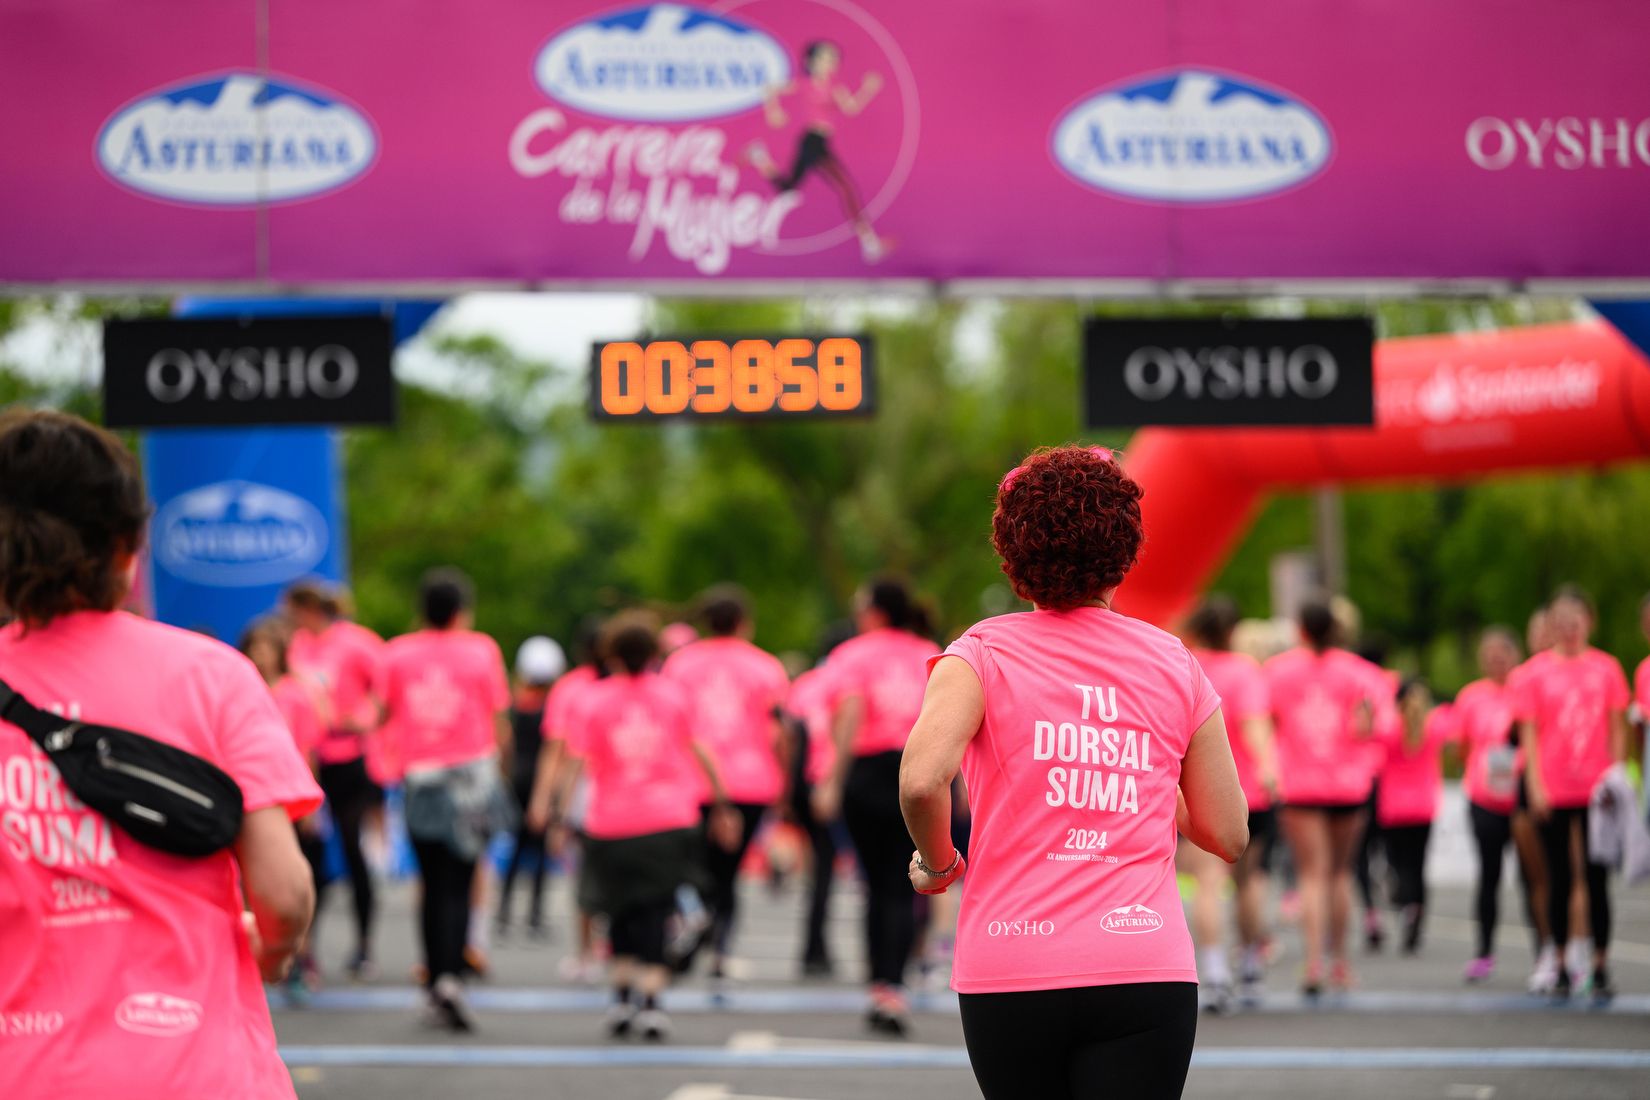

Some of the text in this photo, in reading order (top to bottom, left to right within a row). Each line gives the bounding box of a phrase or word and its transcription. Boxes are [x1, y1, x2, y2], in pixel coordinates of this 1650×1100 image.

[146, 344, 358, 402] OYSHO
[1123, 345, 1339, 401] OYSHO
[1074, 684, 1118, 723] TU
[1033, 720, 1154, 772] DORSAL
[1045, 766, 1139, 814] SUMA
[1055, 853, 1091, 862] ANIVERSARIO
[1064, 828, 1107, 850] 2024
[987, 920, 1055, 937] OYSHO
[1105, 916, 1160, 928] ASTURIANA
